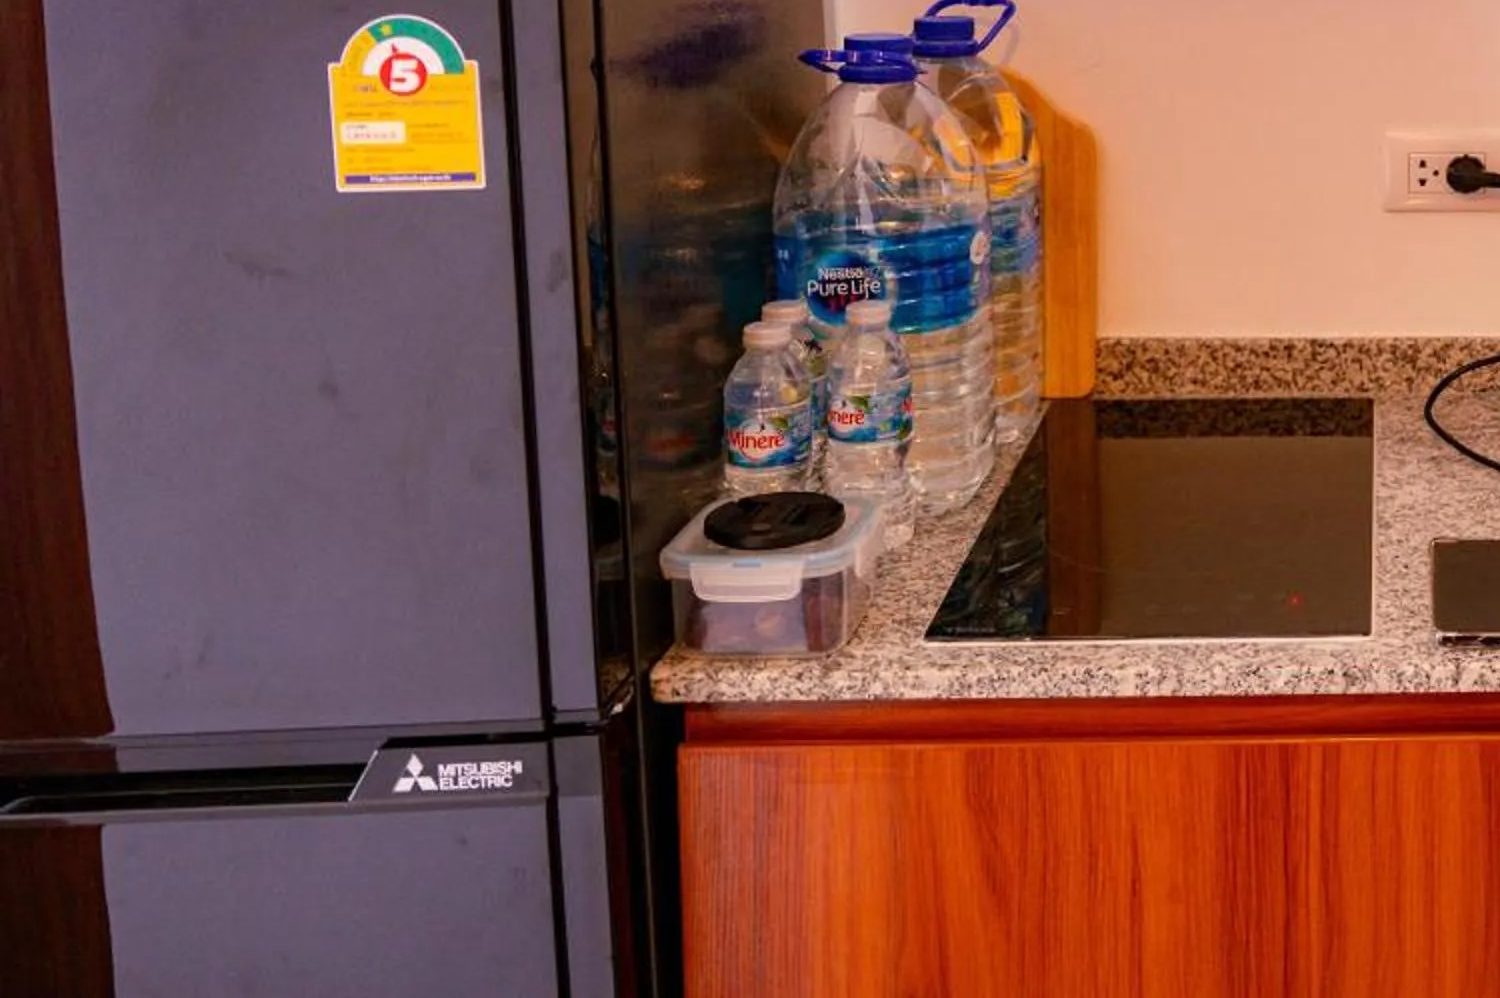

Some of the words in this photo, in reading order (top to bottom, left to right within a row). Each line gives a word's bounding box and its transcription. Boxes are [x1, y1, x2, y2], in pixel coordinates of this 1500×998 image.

[389, 58, 422, 93] 5
[807, 279, 849, 297] Pure
[851, 277, 881, 299] Life
[437, 760, 523, 778] MITSUBISHI
[439, 775, 513, 791] ELECTRIC
